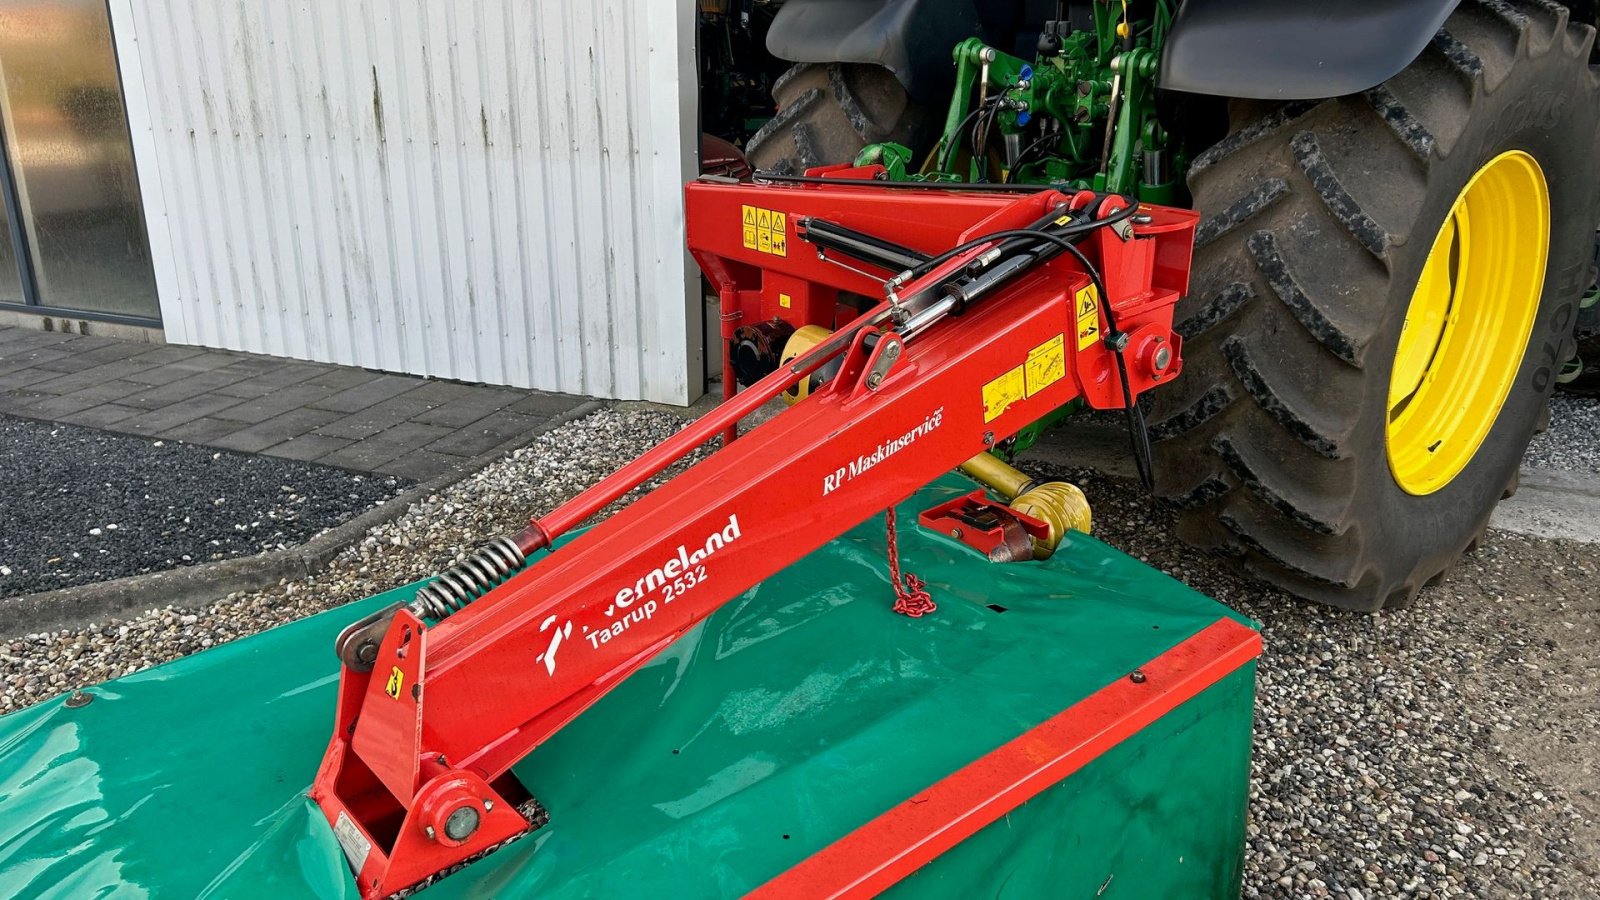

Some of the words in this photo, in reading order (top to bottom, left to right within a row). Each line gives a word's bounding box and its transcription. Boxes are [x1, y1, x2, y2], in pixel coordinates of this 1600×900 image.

[823, 467, 846, 496] RP
[847, 412, 943, 481] Maskinservice
[582, 513, 742, 634] erneland
[585, 600, 657, 650] Taarup
[661, 564, 708, 604] 2532
